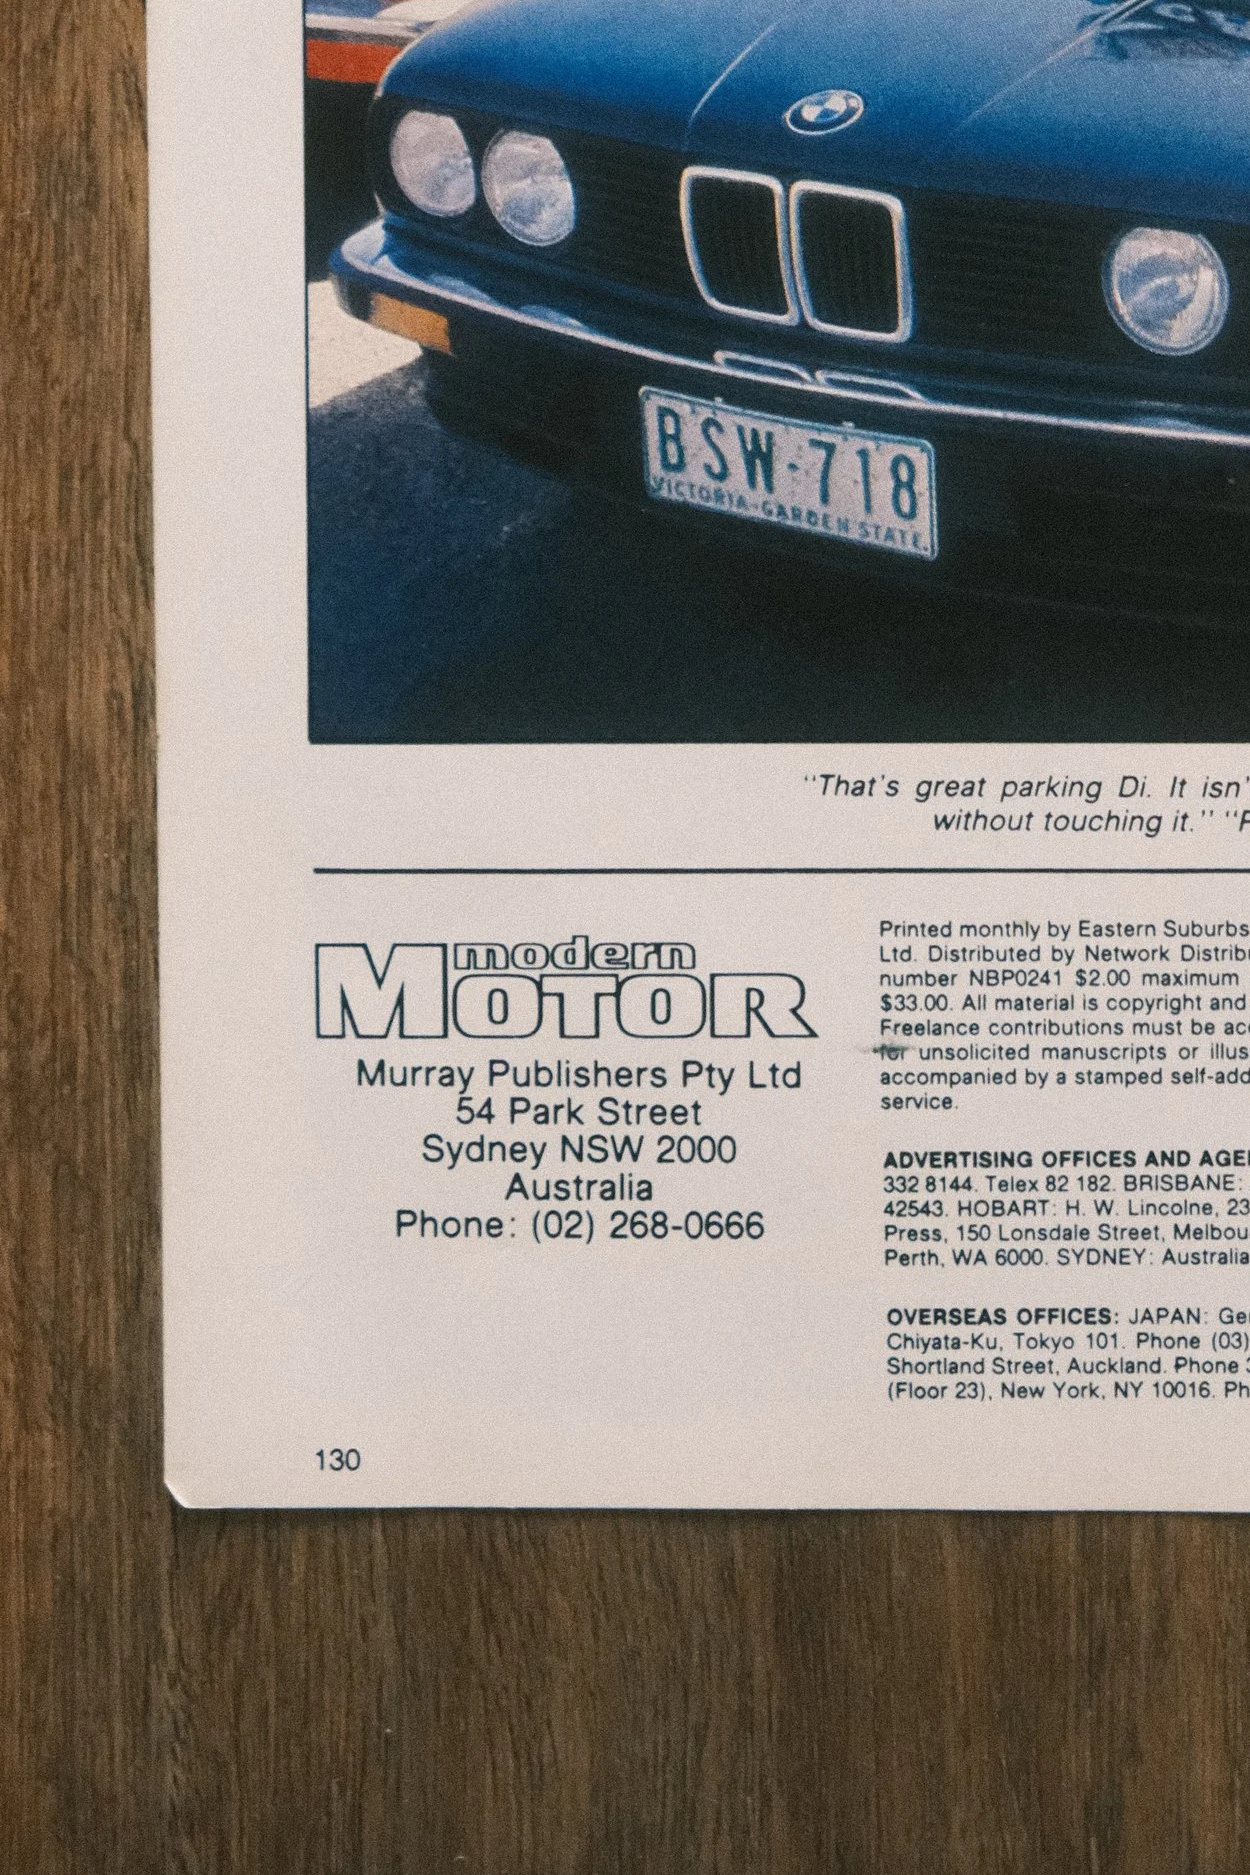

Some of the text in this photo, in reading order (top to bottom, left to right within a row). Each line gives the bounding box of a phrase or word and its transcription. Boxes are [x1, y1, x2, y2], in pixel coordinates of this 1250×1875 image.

[915, 777, 986, 802] great
[1000, 775, 1102, 803] parking
[1118, 775, 1150, 797] Di.
[1169, 776, 1186, 797] It
[934, 809, 1033, 832] without
[1044, 809, 1163, 839] touching
[879, 920, 951, 937] Printed
[959, 920, 1039, 941] monthly
[1047, 921, 1070, 941] by
[1078, 919, 1155, 937] Eastern
[1163, 919, 1249, 937] Suburbs
[453, 935, 696, 970] modern
[315, 942, 819, 1039] MOTOR
[880, 1018, 979, 1036] Freelance
[988, 1019, 1123, 1035] contributions
[1132, 1020, 1181, 1035] must
[1191, 1018, 1214, 1035] be
[357, 1059, 800, 1095] Murray Publishers Pty Ltd
[456, 1095, 701, 1125] 54 Park Street
[422, 1133, 736, 1169] Sydney NSW 2000
[883, 1150, 1032, 1168] ADVERTISING
[1041, 1150, 1137, 1167] OFFICES
[1145, 1150, 1190, 1167] AND
[505, 1172, 652, 1201] Australia
[396, 1209, 764, 1244] Phone: (02) 268-0666
[886, 1307, 1006, 1325] OVERSEAS
[1016, 1307, 1118, 1325] OFFICES:
[1129, 1307, 1205, 1324] JAPAN:
[888, 1381, 947, 1400] (Floor
[955, 1381, 991, 1400] 23),
[1001, 1382, 1044, 1398] New
[1053, 1382, 1104, 1399] York,
[1114, 1381, 1142, 1397] NY
[1153, 1380, 1215, 1398] 10016.
[316, 1448, 360, 1471] 130
